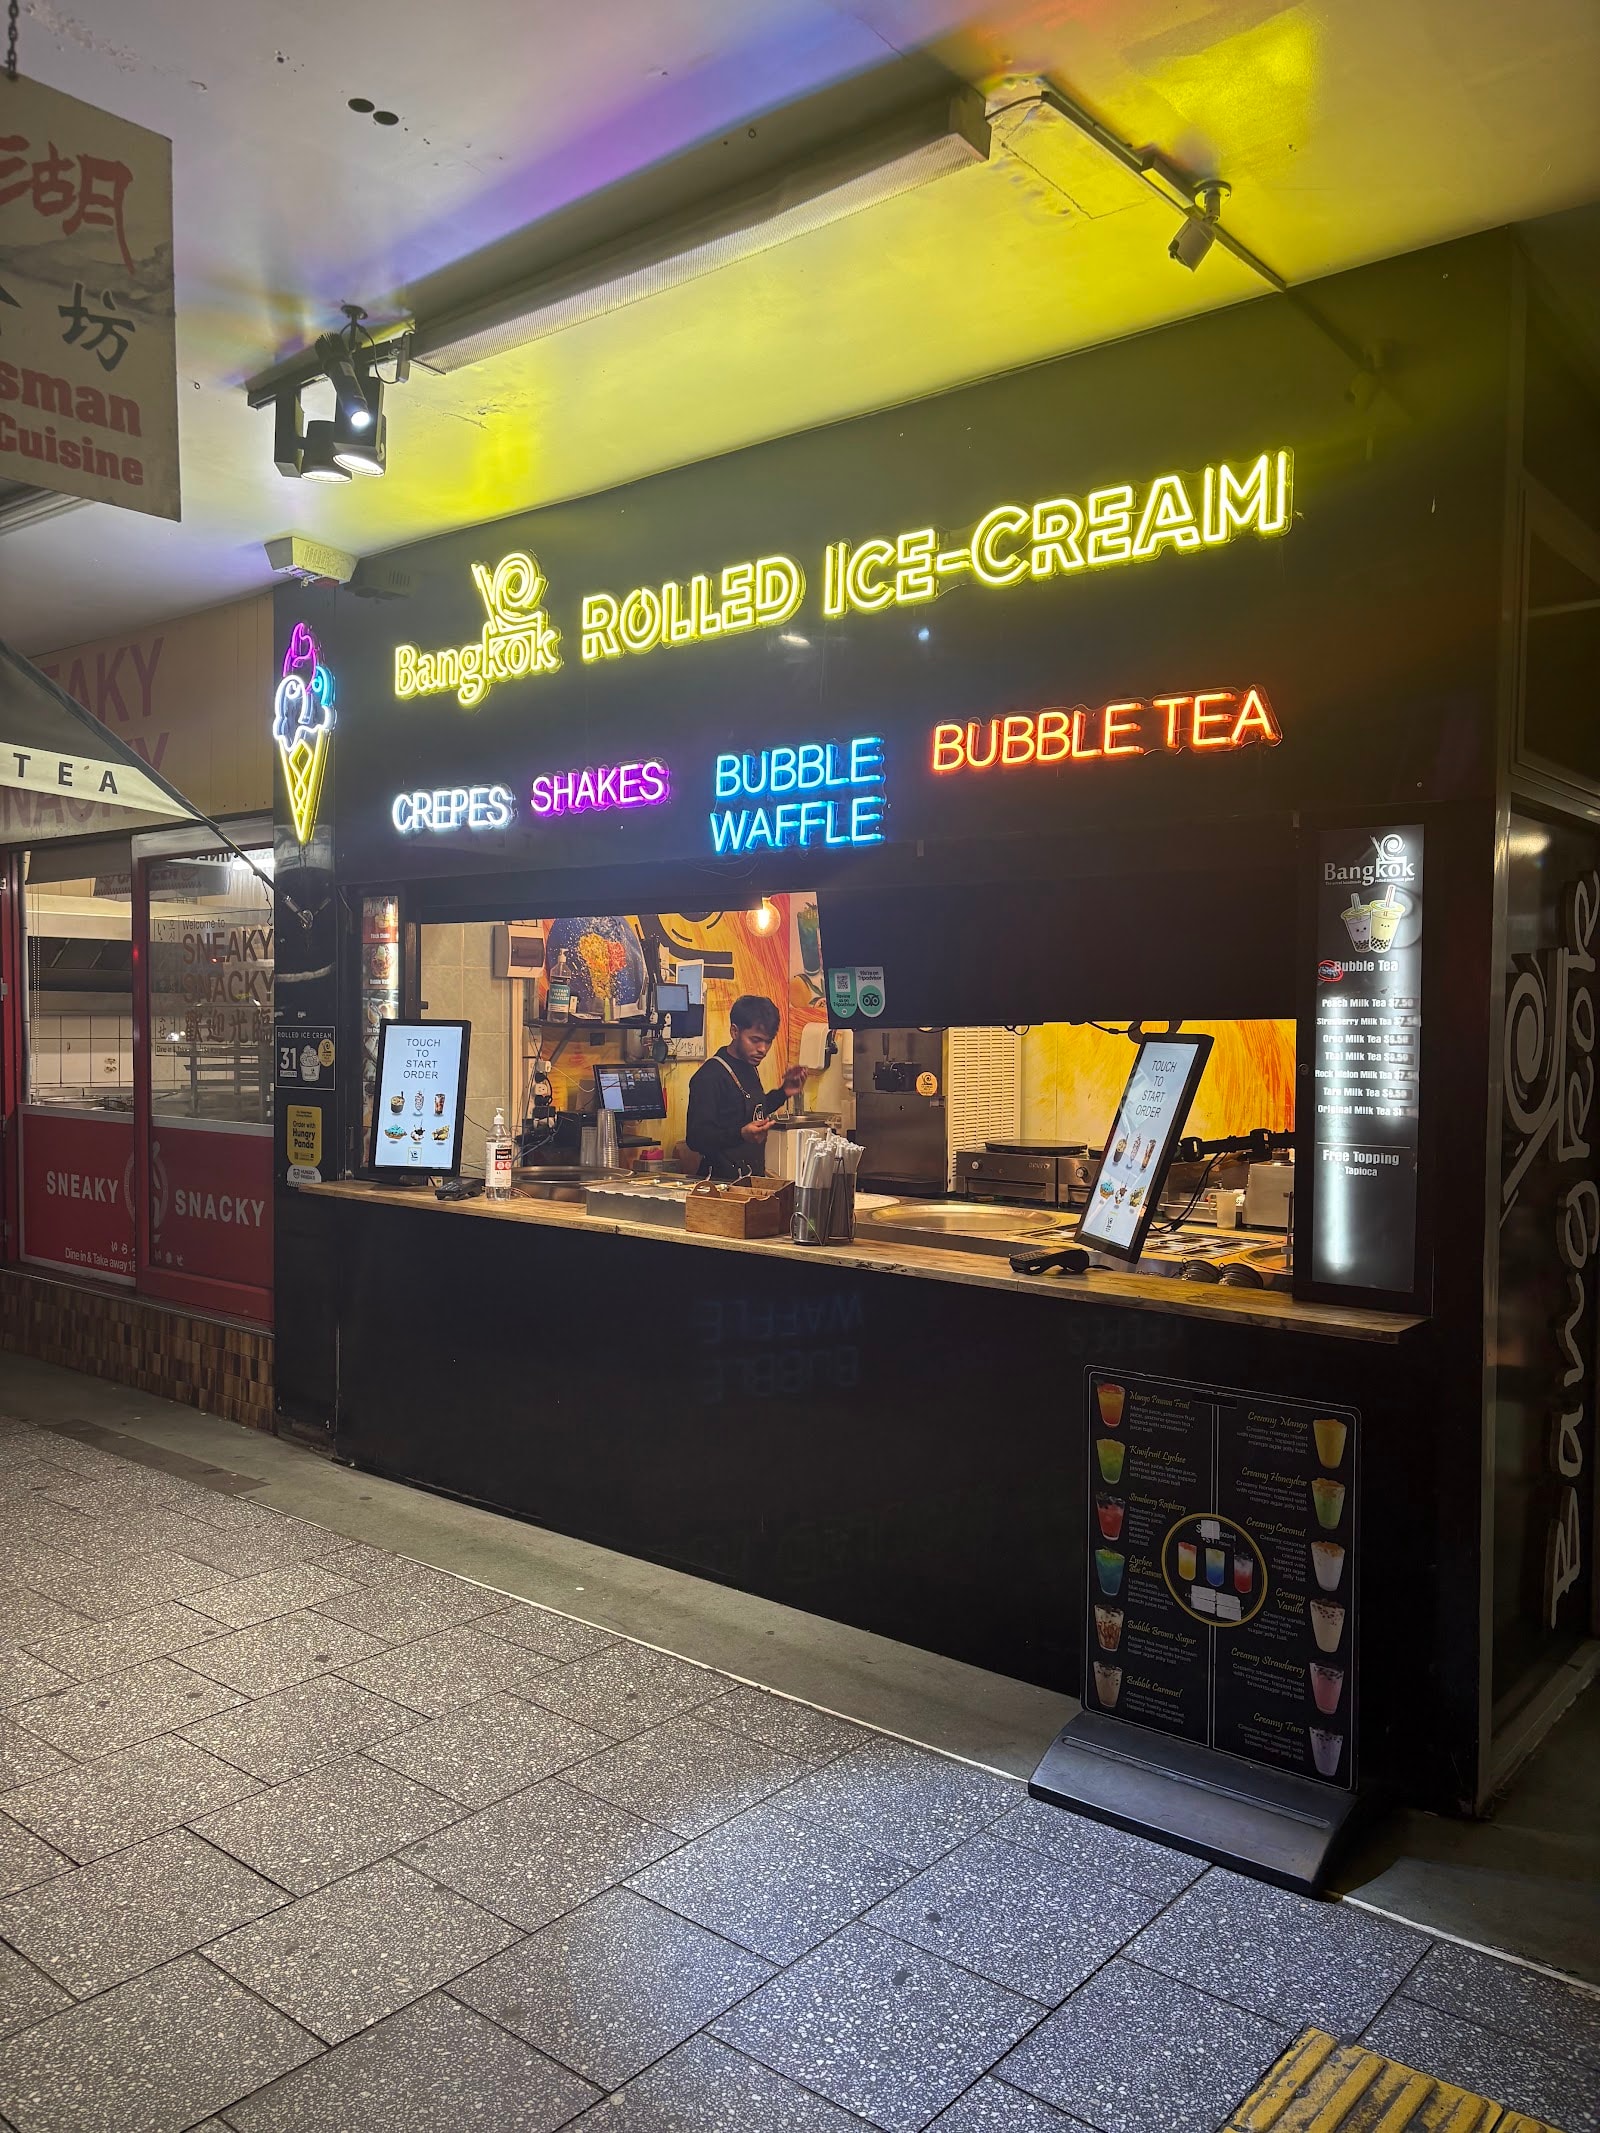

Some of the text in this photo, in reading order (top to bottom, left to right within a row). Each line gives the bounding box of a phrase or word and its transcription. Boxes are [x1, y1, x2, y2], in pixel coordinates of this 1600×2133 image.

[0, 412, 144, 487] Cuisine
[581, 450, 1290, 661] ROLLED ICE-CREAM
[394, 620, 562, 706] Bangkok
[932, 690, 1281, 771] BUBBLE TEA
[13, 752, 119, 795] TEA
[715, 737, 884, 797] BUBBLE
[530, 761, 670, 814] SHAKES
[392, 786, 513, 831] CREPES
[710, 796, 885, 853] WAFFLE
[1324, 858, 1415, 886] Bangkok
[183, 918, 225, 930] Welcome to
[182, 928, 274, 966] SNEAKY
[1334, 960, 1374, 972] Bubble
[1378, 960, 1399, 972] Tea
[182, 970, 274, 1003] SNACKY
[1350, 999, 1369, 1008] Milk
[1372, 999, 1386, 1008] Tea
[1360, 1018, 1377, 1026] Milk
[1379, 1018, 1392, 1026] Tea
[277, 1031, 299, 1039] ROLLED
[406, 1038, 441, 1047] TOUCH
[1345, 1034, 1364, 1044] Milk
[1367, 1035, 1381, 1044] Tea
[280, 1047, 297, 1070] 31
[416, 1049, 429, 1057] TO
[1345, 1052, 1364, 1061] Milk
[1367, 1053, 1381, 1061] Tea
[406, 1060, 438, 1068] START
[1151, 1060, 1177, 1073] TOUCH
[403, 1071, 439, 1079] ORDER
[1153, 1076, 1164, 1086] TO
[1360, 1070, 1377, 1079] Milk
[1379, 1071, 1392, 1080] Tea
[1141, 1090, 1166, 1103] START
[1343, 1087, 1363, 1097] Milk
[1365, 1088, 1380, 1097] Tea
[1135, 1104, 1162, 1119] ORDER
[1317, 1105, 1352, 1115] Original
[1354, 1106, 1373, 1115] Milk
[1376, 1107, 1390, 1116] Tea
[292, 1120, 306, 1128] Order
[292, 1128, 316, 1140] Hungry
[294, 1139, 314, 1149] Panda
[1322, 1149, 1400, 1166] Free Topping
[1345, 1166, 1378, 1177] Tapioca
[46, 1171, 266, 1227] SNEAKY SNACKY
[65, 1247, 79, 1260] Dine
[80, 1251, 86, 1261] in
[87, 1252, 92, 1263] &
[92, 1252, 108, 1266] Take
[109, 1257, 127, 1272] away
[1129, 1390, 1151, 1406] Mango
[1248, 1411, 1308, 1433] Creamy Mango
[1241, 1466, 1308, 1489] Creamy Honeydew
[1246, 1516, 1306, 1537] Creamy Coconut
[1275, 1587, 1306, 1605] Creamy
[1277, 1599, 1304, 1614] Vanilla
[1127, 1620, 1197, 1647] Bubble Brown Sugar
[1231, 1647, 1306, 1679] Creamy Strawberry
[1126, 1675, 1184, 1698] Bubble Caramel
[1253, 1712, 1305, 1735] Creamy Taro
